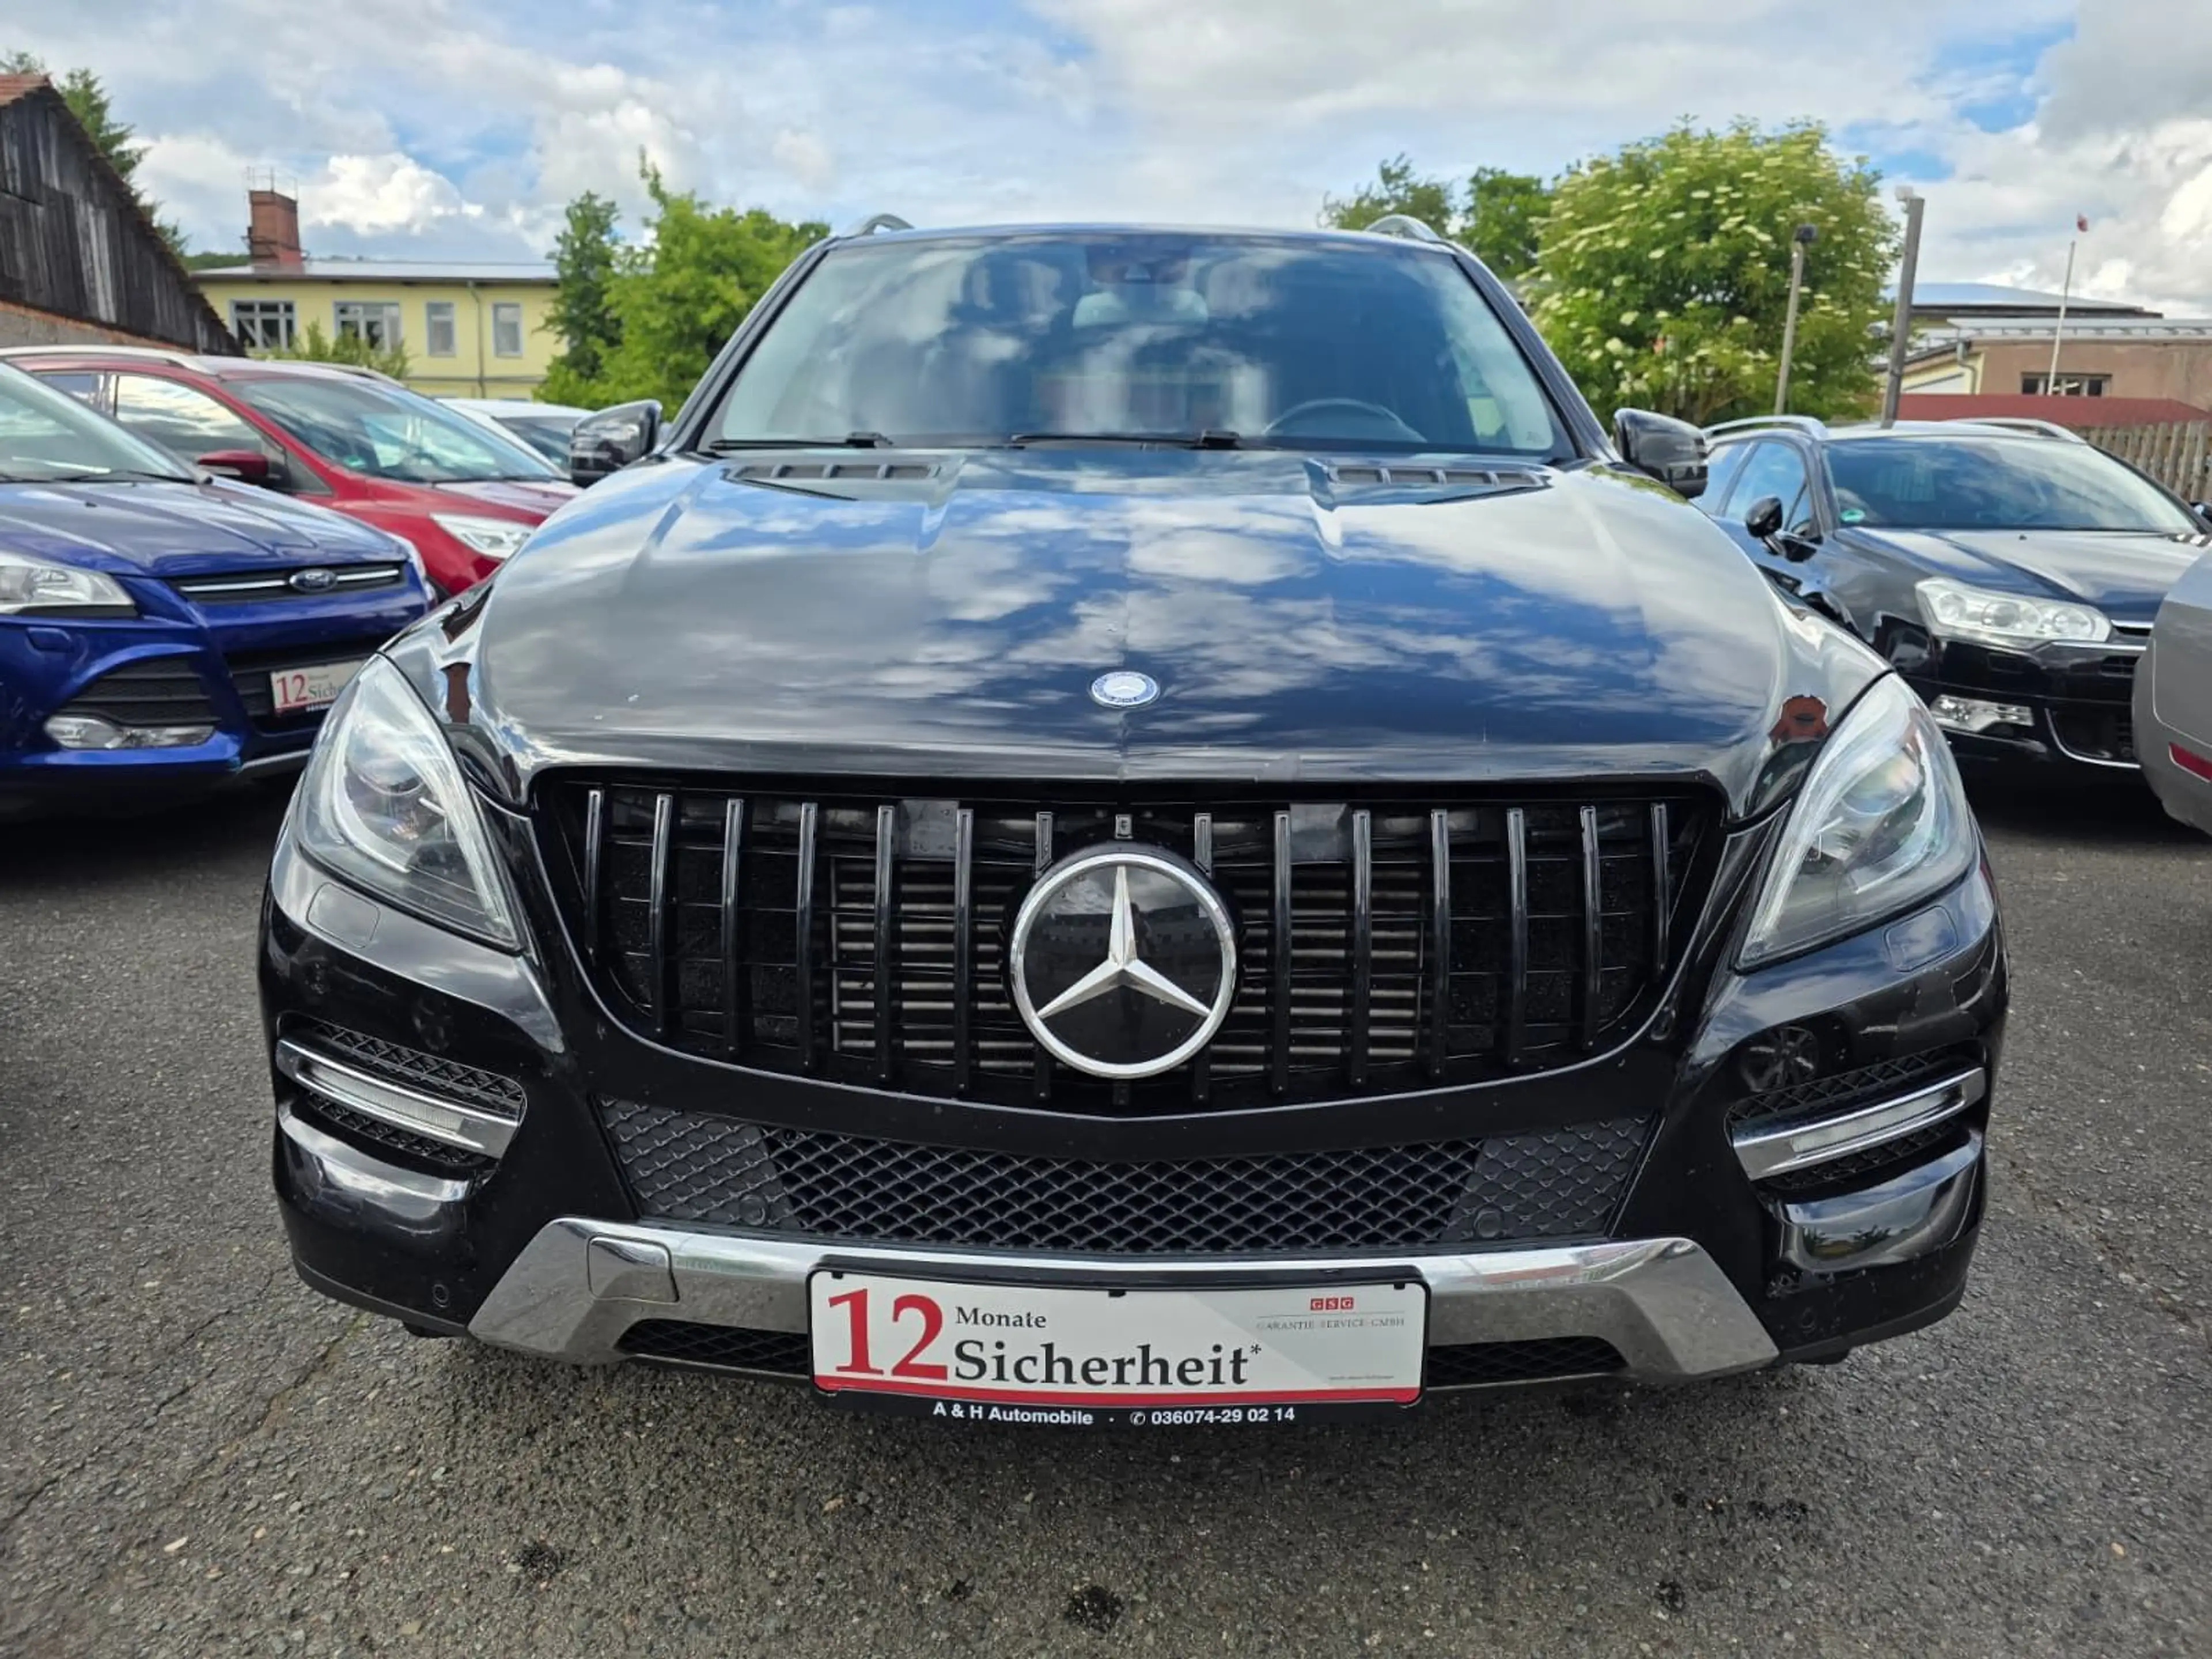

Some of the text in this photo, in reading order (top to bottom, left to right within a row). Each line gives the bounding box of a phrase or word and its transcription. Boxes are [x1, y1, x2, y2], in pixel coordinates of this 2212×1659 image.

[276, 675, 308, 704] 12
[1310, 1297, 1354, 1310] GSG
[956, 1306, 1047, 1328] Monate
[828, 1289, 948, 1381] 12
[933, 1402, 1296, 1425] A & H Automobile 036074-29 02 14
